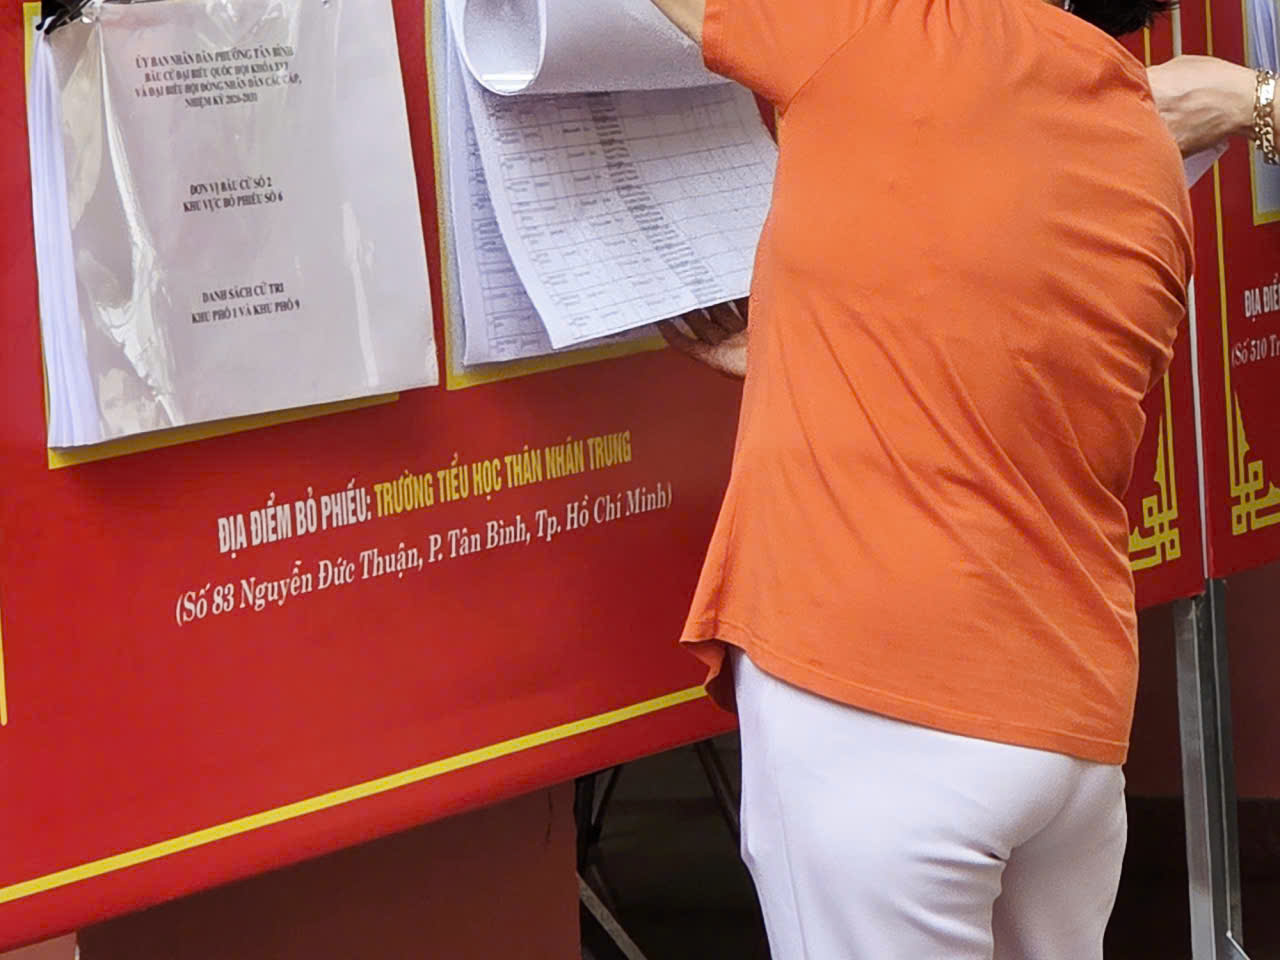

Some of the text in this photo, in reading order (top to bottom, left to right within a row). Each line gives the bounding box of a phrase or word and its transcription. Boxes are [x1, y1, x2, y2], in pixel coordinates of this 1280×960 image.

[1244, 288, 1262, 323] ĐỊA
[1231, 337, 1267, 368] (Số 510
[218, 431, 632, 558] ĐỊA ĐIỂM BỎ PHIẾU: TRƯỜNG TIỂU HỌC THÂN NHÂN TRUNG
[176, 482, 672, 626] (Số 83 Nguyễn Đức Thuận, P. Tân Bình, Tp. Hồ Chí Minh)
